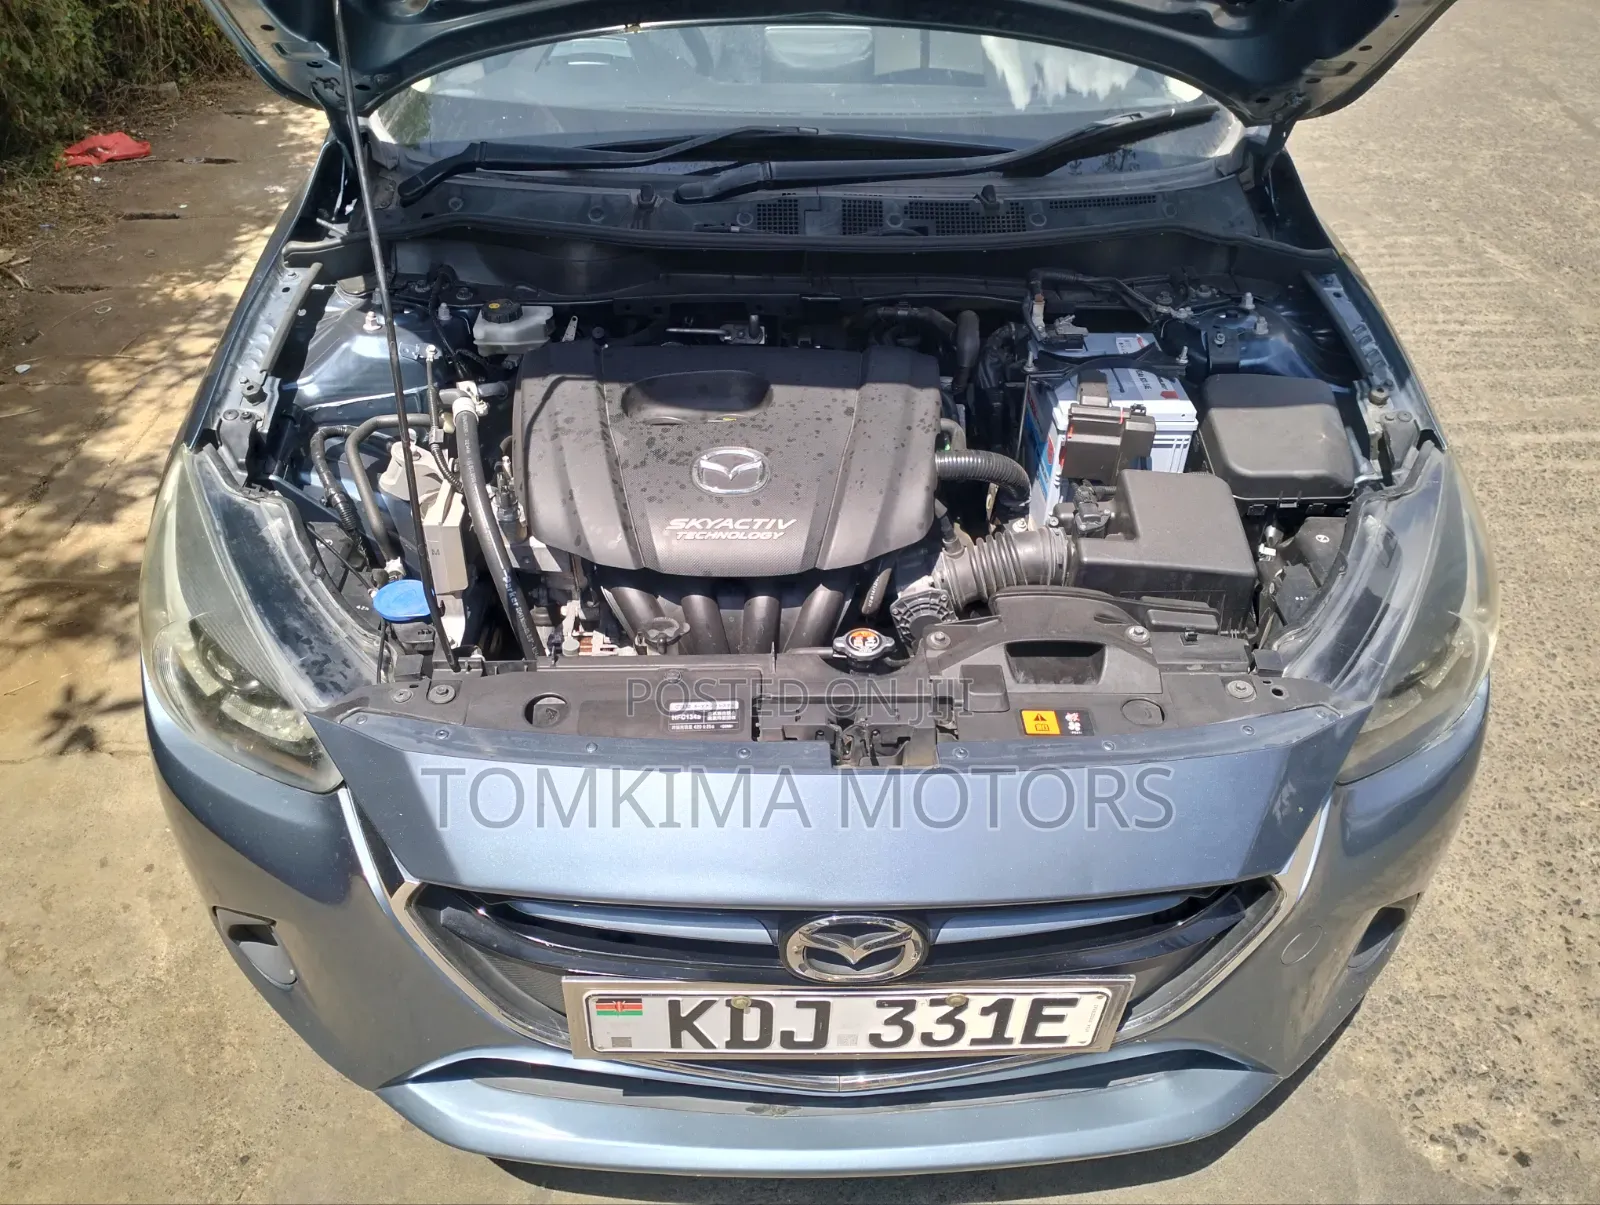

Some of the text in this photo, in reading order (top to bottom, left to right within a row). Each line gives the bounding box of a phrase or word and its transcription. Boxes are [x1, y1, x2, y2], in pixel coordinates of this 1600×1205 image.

[665, 518, 797, 530] SKYACTIV
[676, 531, 785, 540] TECHNOLOGY
[503, 575, 519, 607] Parker
[668, 998, 832, 1050] KDJ
[868, 997, 1080, 1049] 331E
